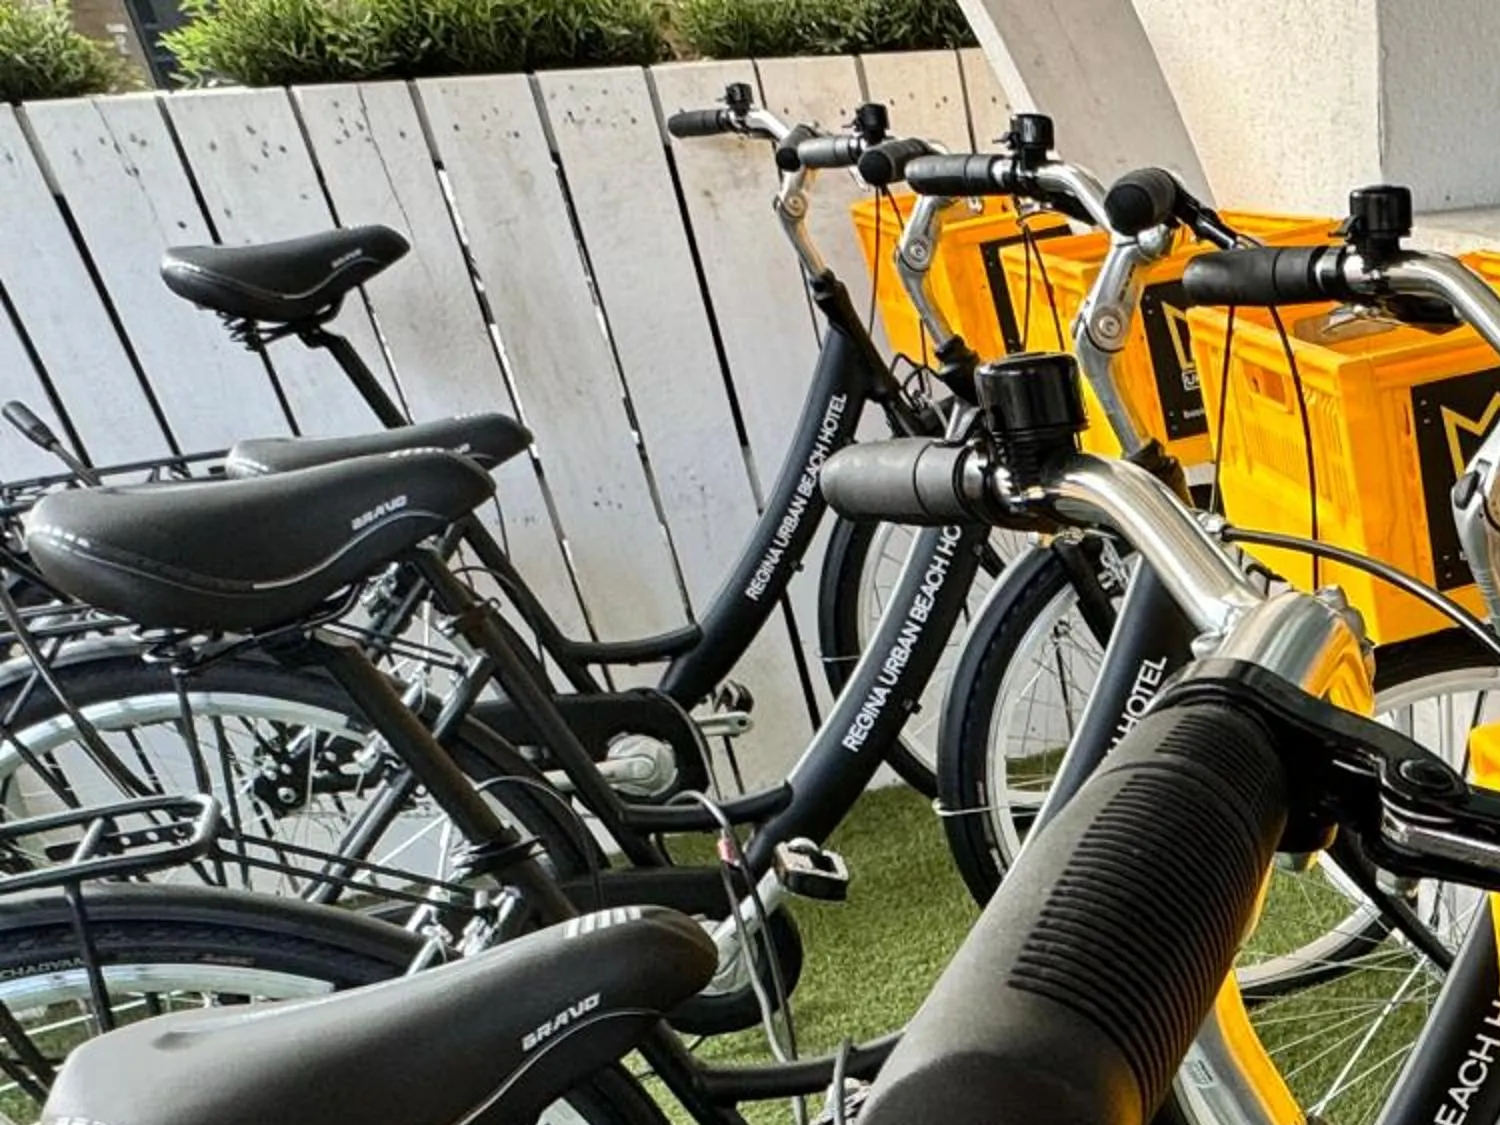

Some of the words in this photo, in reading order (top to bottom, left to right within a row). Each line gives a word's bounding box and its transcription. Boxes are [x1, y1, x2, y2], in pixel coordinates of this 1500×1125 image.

[744, 545, 784, 600] REGINA
[773, 495, 809, 548] URBAN
[797, 443, 830, 498] BEACH
[818, 393, 848, 447] HOTEL
[842, 685, 891, 752] REGINA
[877, 621, 922, 687] URBAN
[909, 556, 950, 624] BEACH
[522, 992, 601, 1051] BRAVO
